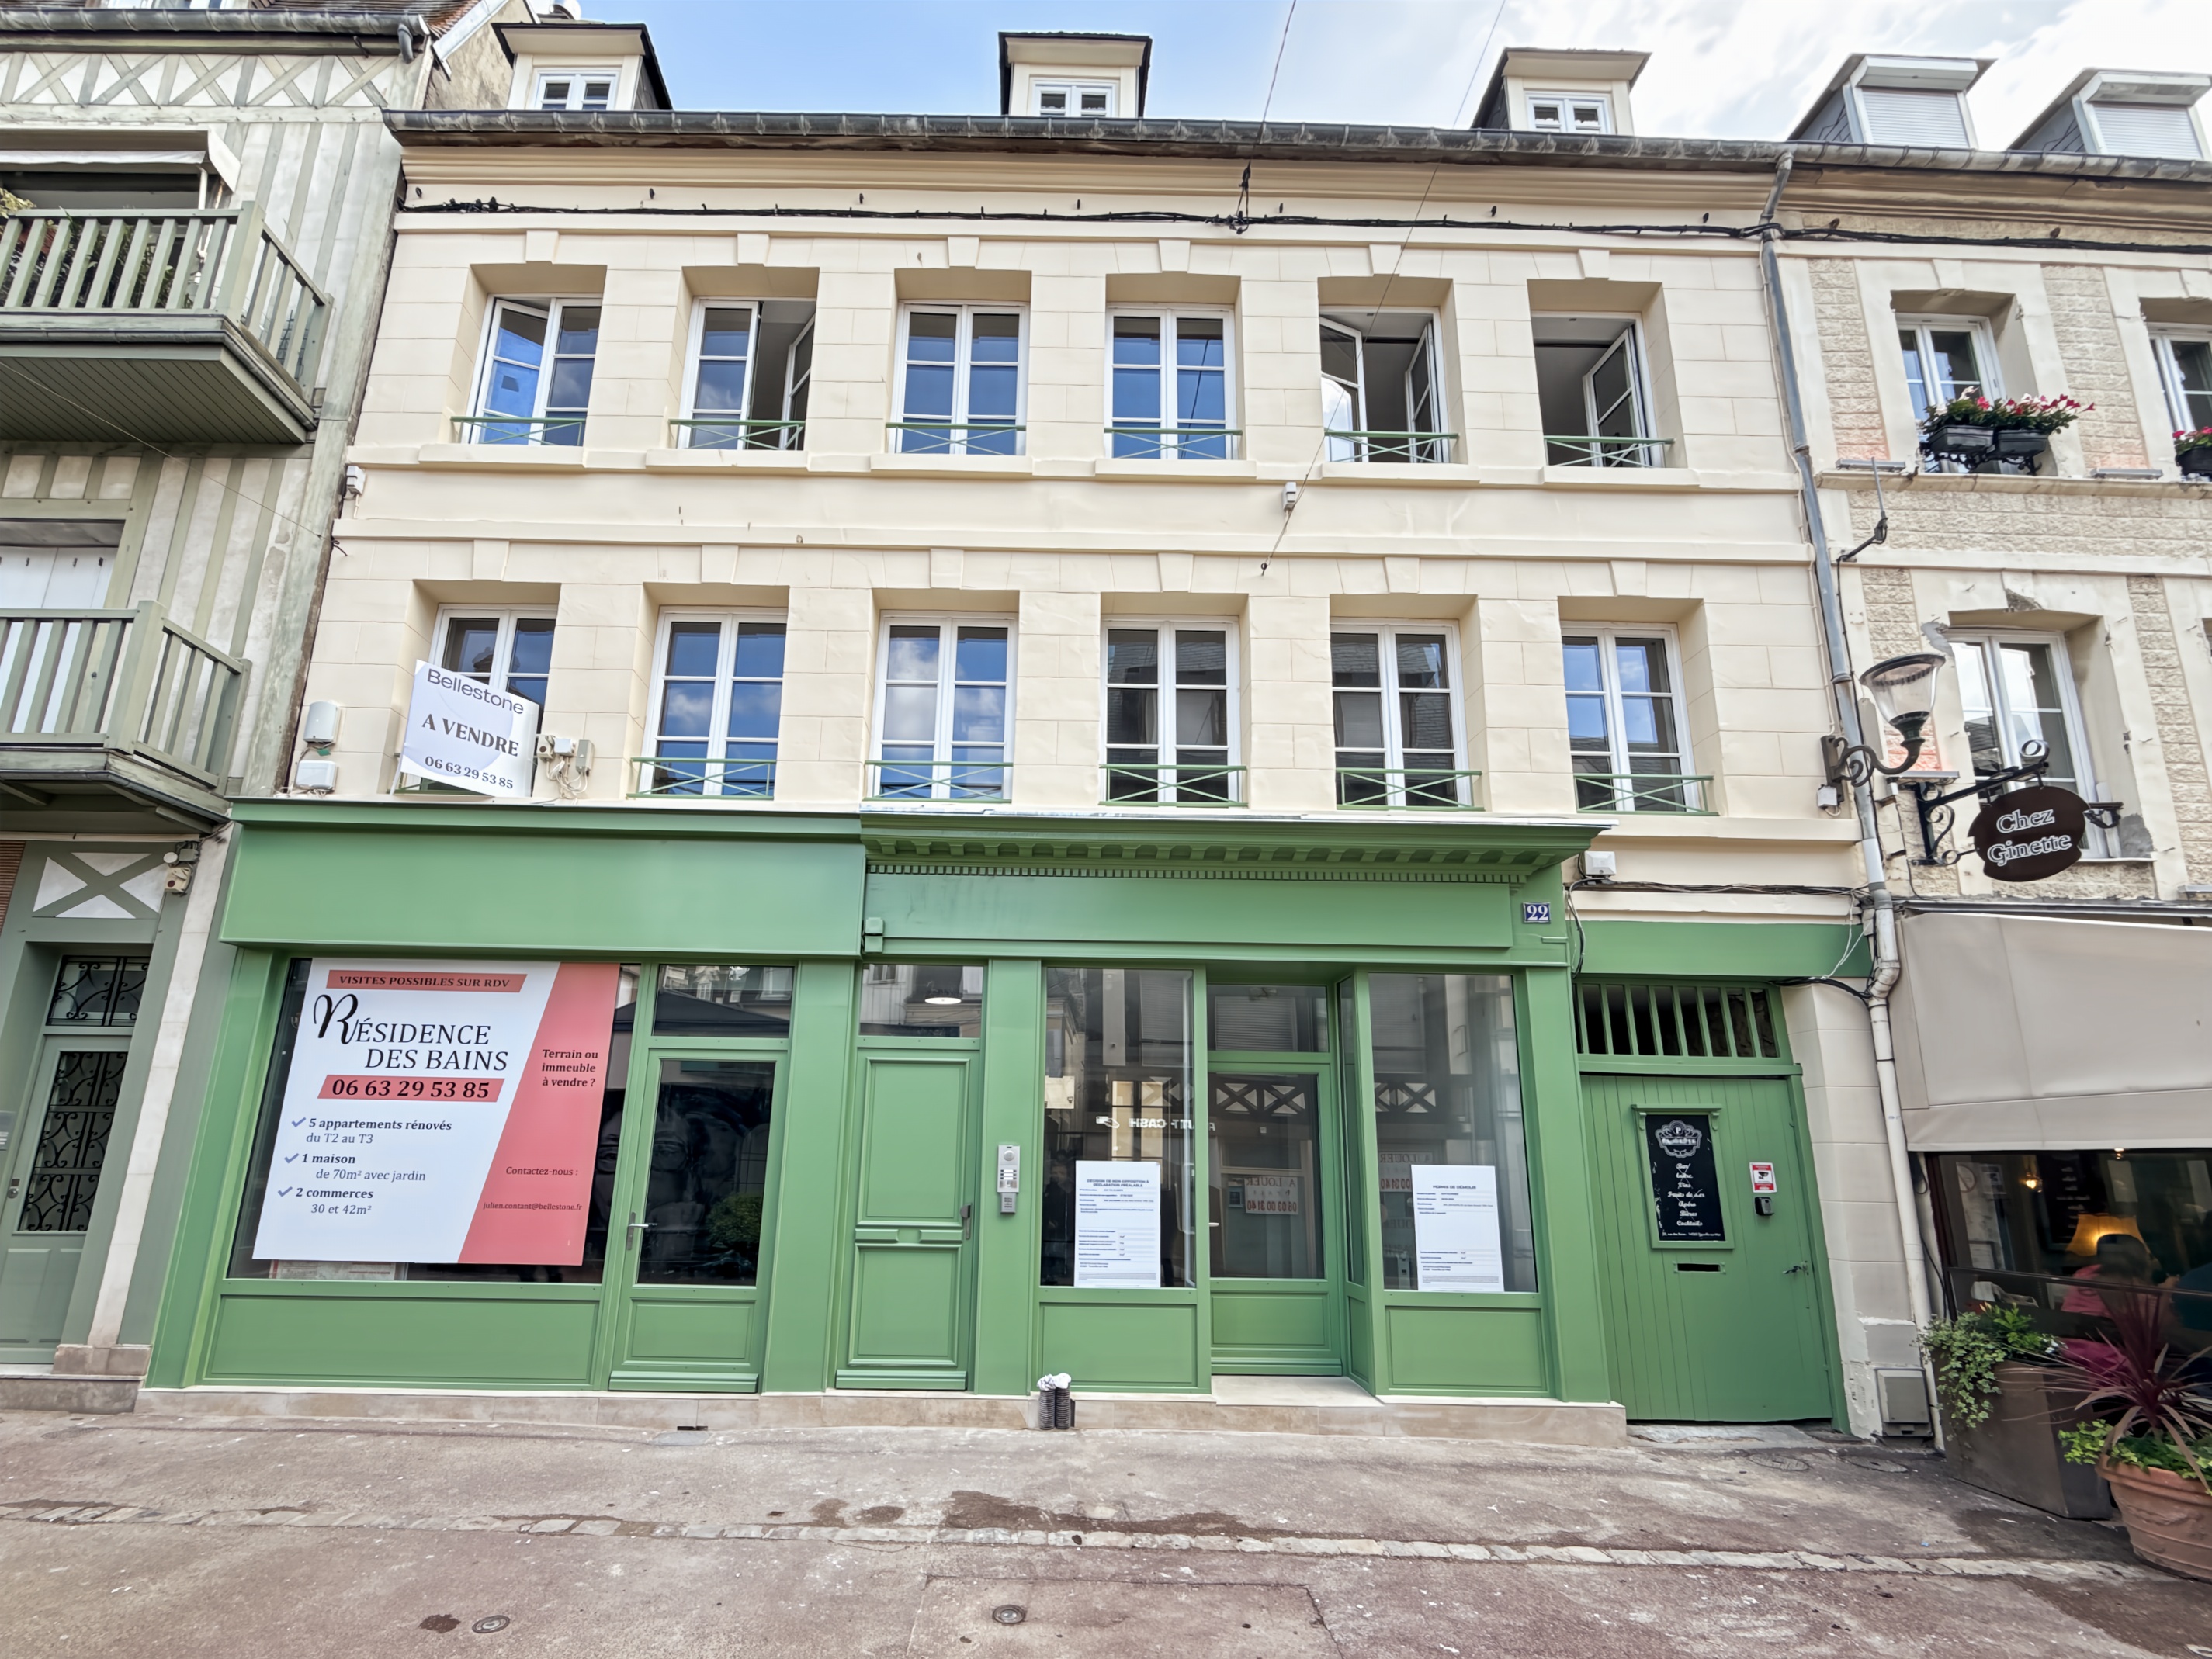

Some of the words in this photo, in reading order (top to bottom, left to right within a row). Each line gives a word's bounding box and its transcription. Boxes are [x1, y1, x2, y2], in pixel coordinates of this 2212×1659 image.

[428, 668, 524, 715] Bellestone
[421, 713, 436, 731] A
[442, 717, 519, 757] VENDRE
[425, 756, 443, 770] 06
[446, 762, 462, 774] 63
[463, 767, 480, 779] 29
[481, 772, 497, 784] 53
[499, 777, 514, 789] 85
[1996, 809, 2055, 834] Chez
[1987, 834, 2072, 867] Ginette
[1527, 905, 1548, 920] 22
[339, 976, 387, 985] VISITES
[389, 977, 456, 987] POSSIBLES
[456, 978, 481, 987] SUR
[484, 979, 510, 988] RDV
[313, 993, 491, 1045] RÉSIDENCE
[365, 1048, 418, 1069] DES
[425, 1050, 508, 1072] BAINS
[542, 1049, 582, 1059] Terrain
[584, 1051, 598, 1059] ou
[542, 1062, 596, 1073] immeuble
[542, 1077, 549, 1086] à
[551, 1077, 588, 1087] vendre
[591, 1078, 596, 1087] ?
[332, 1079, 359, 1096] 06
[365, 1079, 391, 1096] 63
[397, 1080, 425, 1097] 29
[430, 1081, 456, 1098] 53
[463, 1082, 490, 1099] 85
[309, 1118, 317, 1128] 5
[318, 1120, 403, 1131] appartements
[405, 1120, 452, 1131] rénovés
[306, 1132, 321, 1143] du
[324, 1133, 339, 1143] T2
[342, 1134, 355, 1144] au
[359, 1134, 373, 1144] T3
[301, 1153, 308, 1163] 1
[311, 1154, 356, 1164] maison
[315, 1169, 330, 1179] de
[332, 1169, 362, 1179] 70m²
[364, 1172, 390, 1180] avec
[390, 1170, 426, 1183] jardin
[505, 1166, 574, 1176] Contactez-nous
[296, 1187, 303, 1197] 2
[306, 1189, 374, 1199] commerces
[310, 1204, 325, 1214] 30
[328, 1204, 339, 1214] et
[342, 1204, 372, 1215] 42m²
[483, 1201, 583, 1210] julien.contant@bellestone.fr
